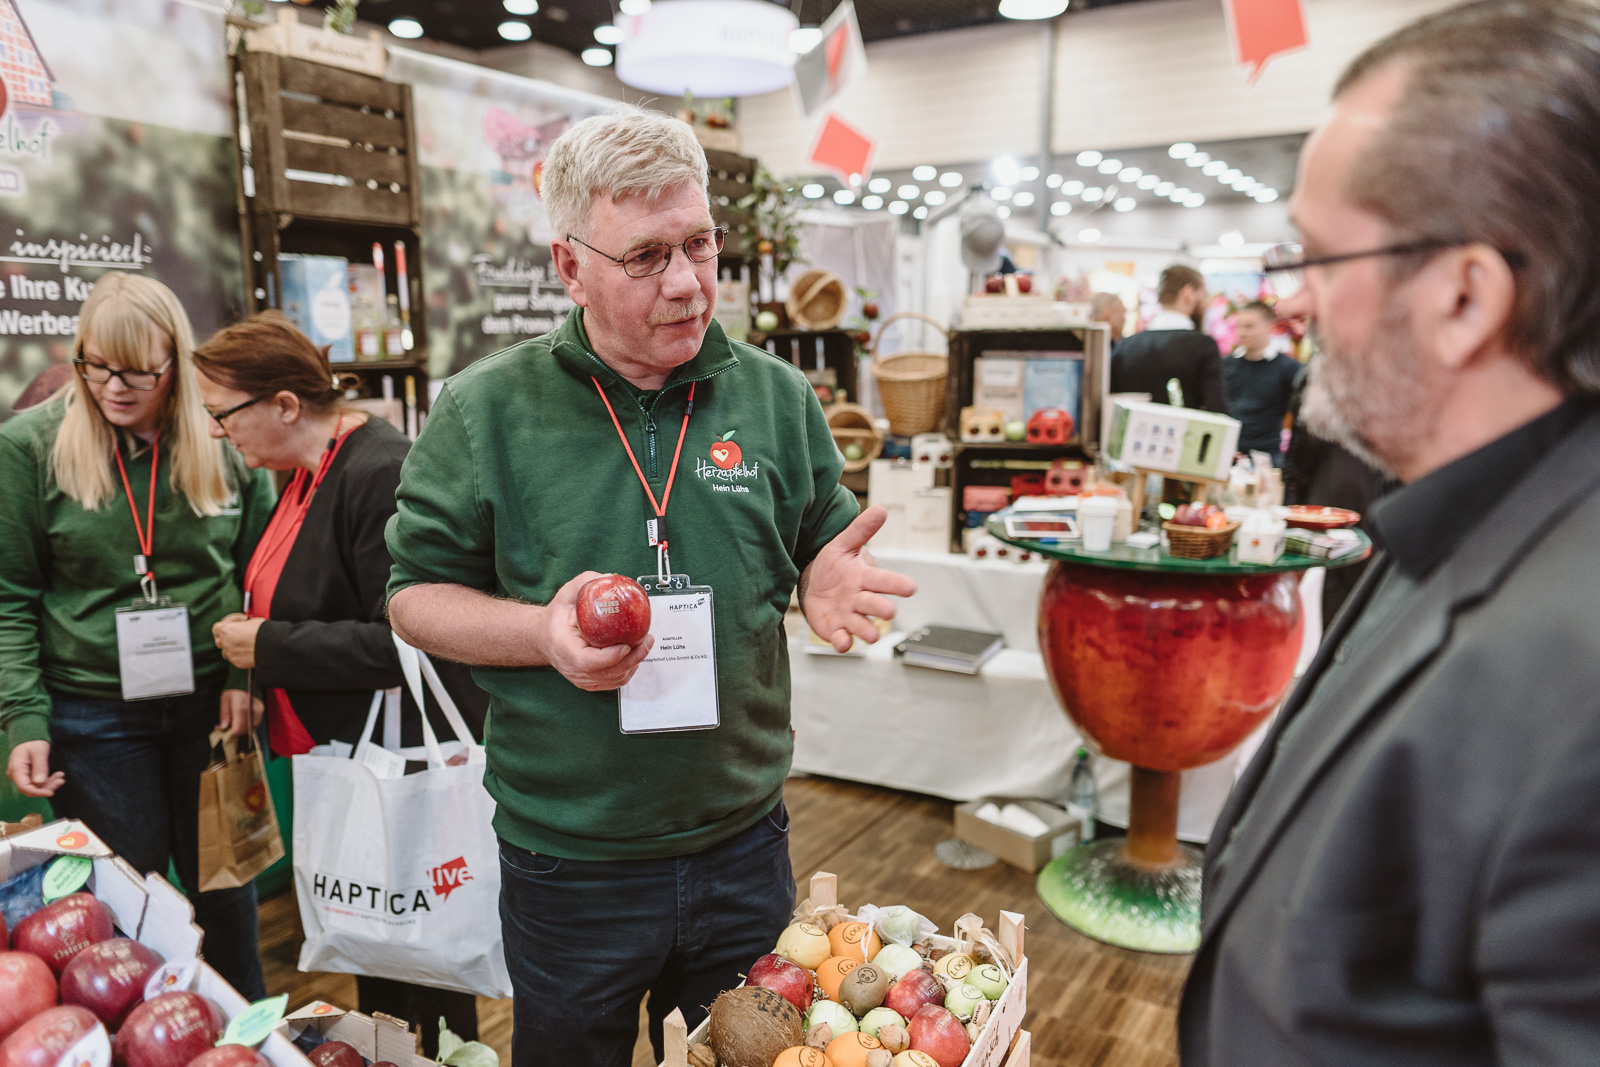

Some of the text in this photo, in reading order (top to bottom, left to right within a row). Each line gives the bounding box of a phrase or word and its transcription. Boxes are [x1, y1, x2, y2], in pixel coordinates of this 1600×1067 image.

[10, 275, 61, 301] Ihre
[694, 456, 760, 482] Herzapfelhof
[712, 484, 749, 493] Hein Lühs
[669, 603, 698, 611] HAPTICA
[313, 873, 431, 915] HAPTICA
[54, 939, 91, 960] Ostern
